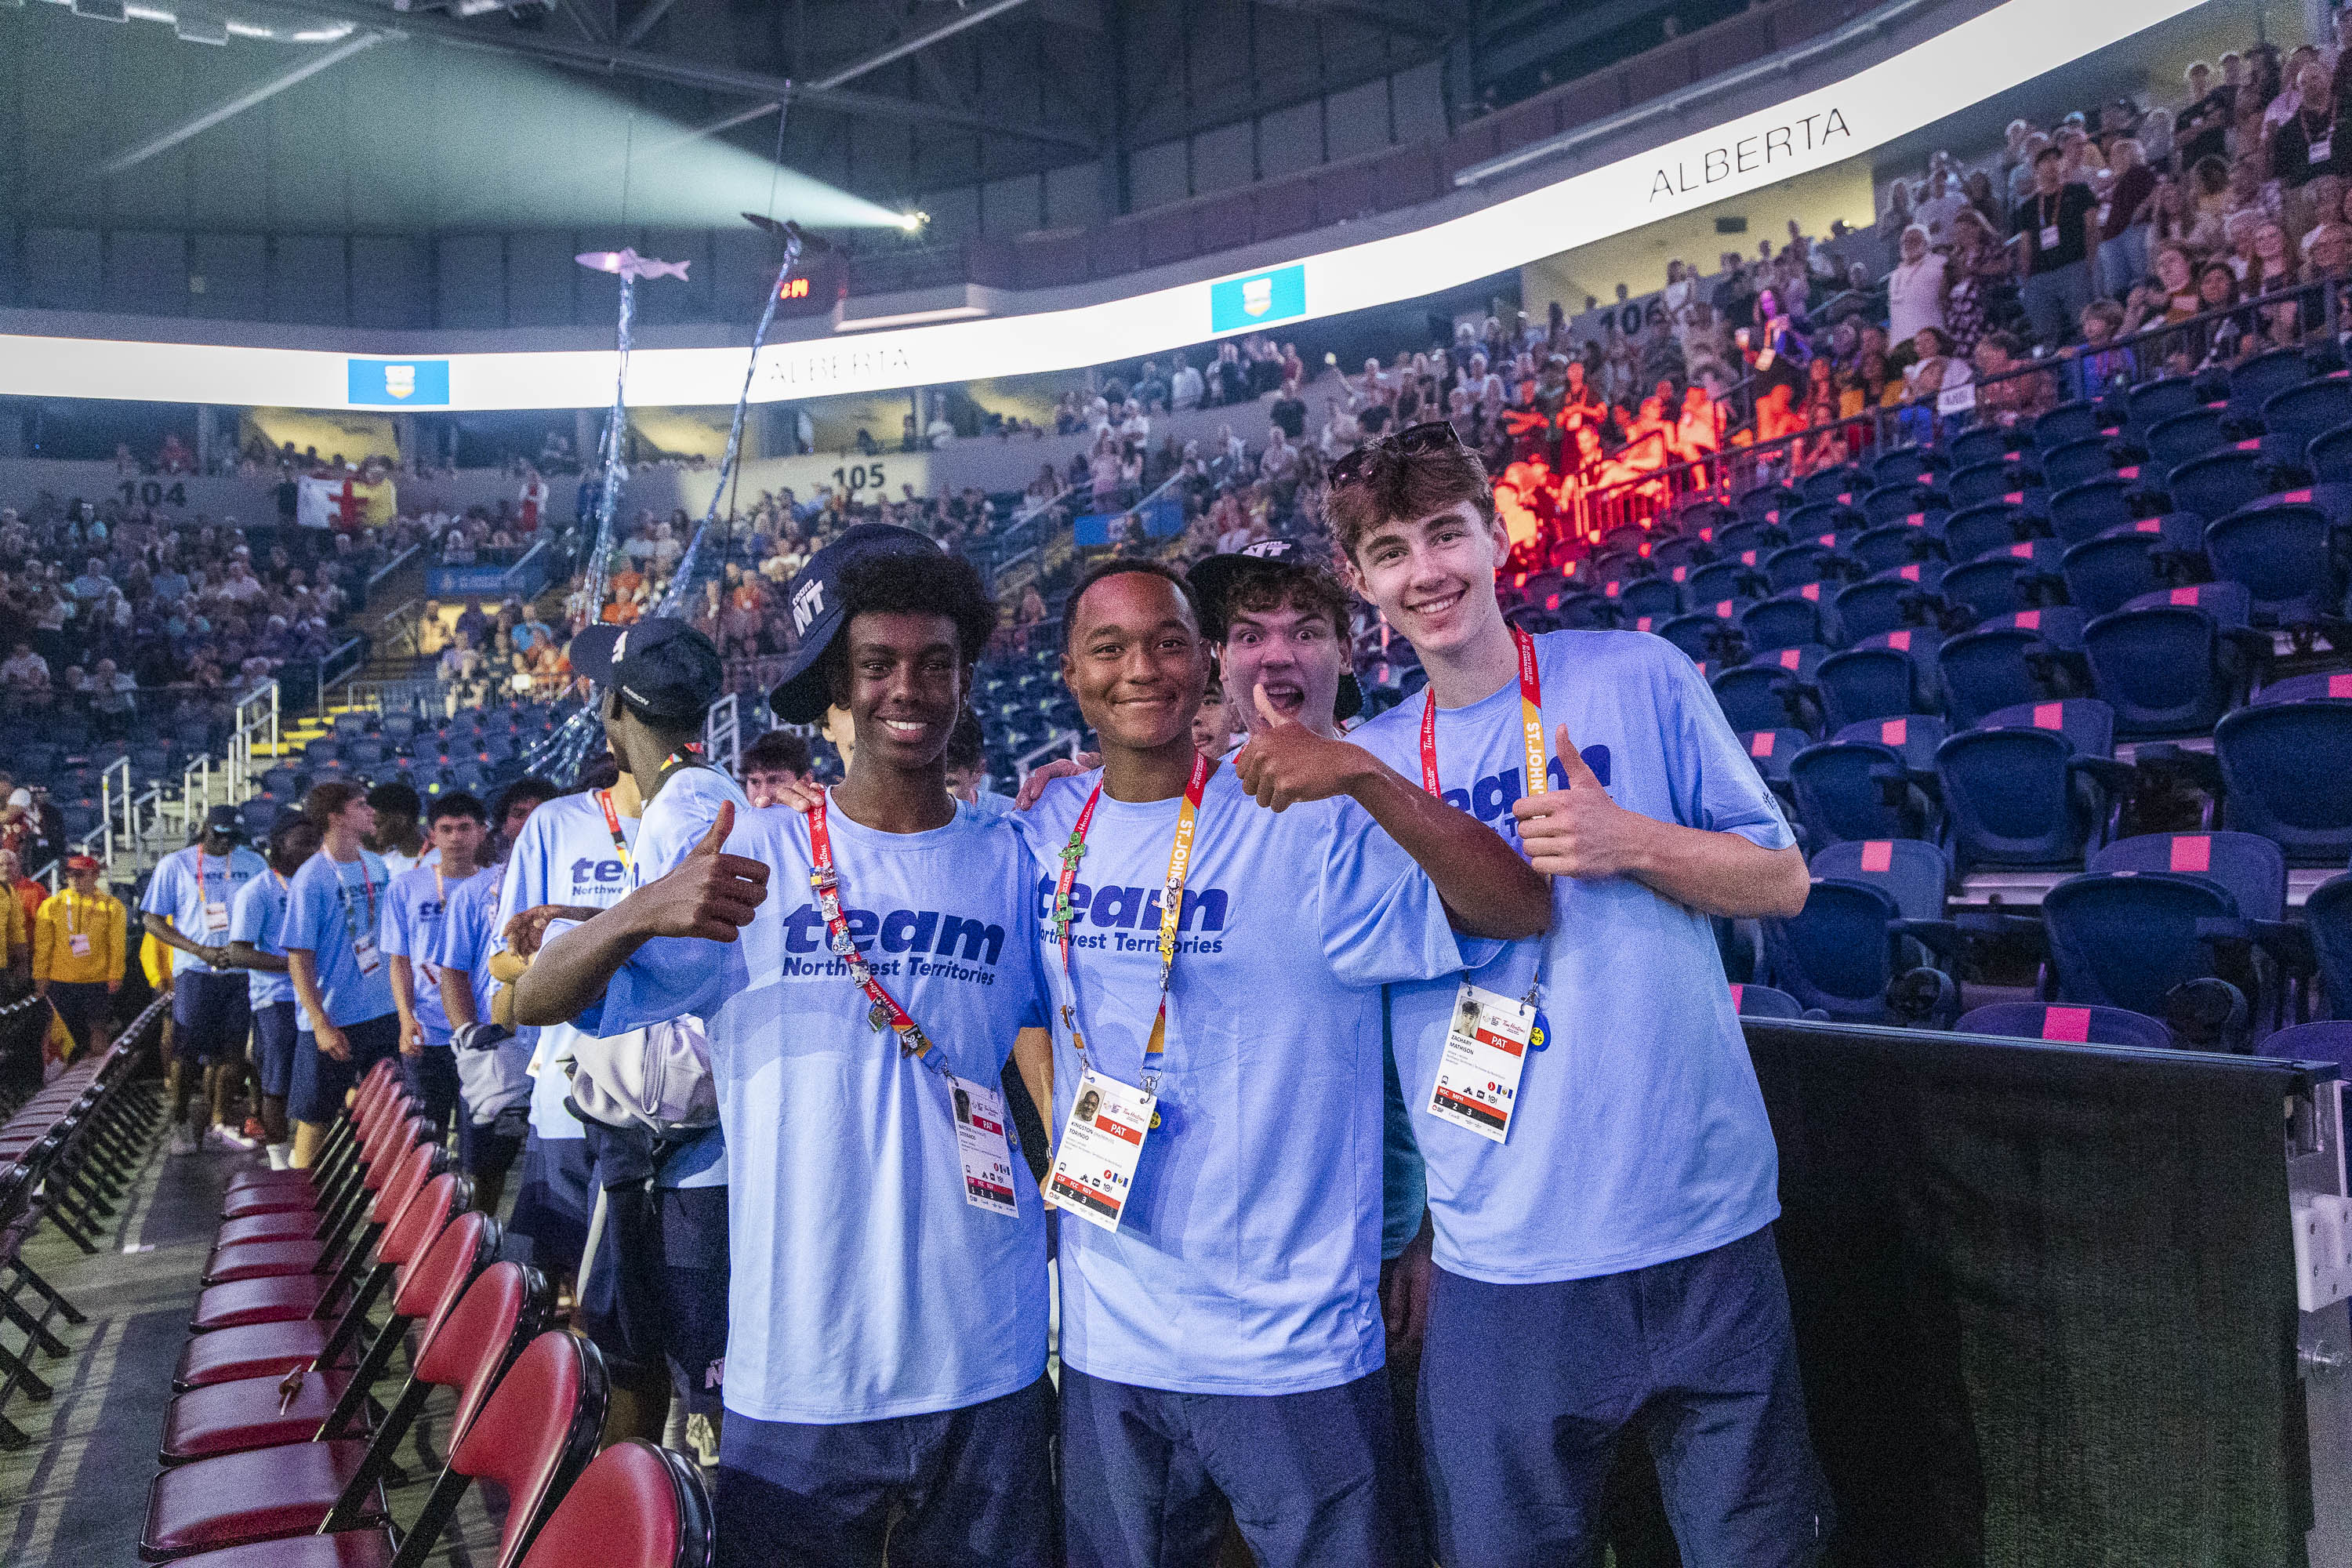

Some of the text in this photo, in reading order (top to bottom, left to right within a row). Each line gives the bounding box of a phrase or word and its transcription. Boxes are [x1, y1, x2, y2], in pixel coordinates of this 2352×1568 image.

[1650, 108, 1850, 202] ALBERTA
[768, 349, 910, 383] ALBERTA
[833, 463, 884, 489] 105
[118, 481, 186, 508] 104
[792, 579, 814, 606] team
[793, 580, 824, 637] NT
[1424, 735, 1432, 751] Tim
[1526, 722, 1544, 794] ST.JOHN'
[1441, 744, 1610, 822] eam
[1078, 803, 1094, 830] Hortons
[1171, 819, 1192, 880] ST.JOHN
[572, 858, 626, 884] te
[572, 884, 623, 895] Northwe
[1038, 872, 1229, 931] team
[783, 903, 1006, 965] team
[1114, 931, 1222, 953] Terriories
[782, 956, 995, 985] Northest Territories
[1449, 1042, 1474, 1055] MATHISON
[1450, 1035, 1472, 1047] ZACHARY
[1491, 1036, 1508, 1049] PAT
[982, 1120, 993, 1131] PAT
[1069, 1128, 1090, 1141] TORINDO
[1071, 1121, 1094, 1134] KINGSTON
[1110, 1123, 1127, 1137] PAT
